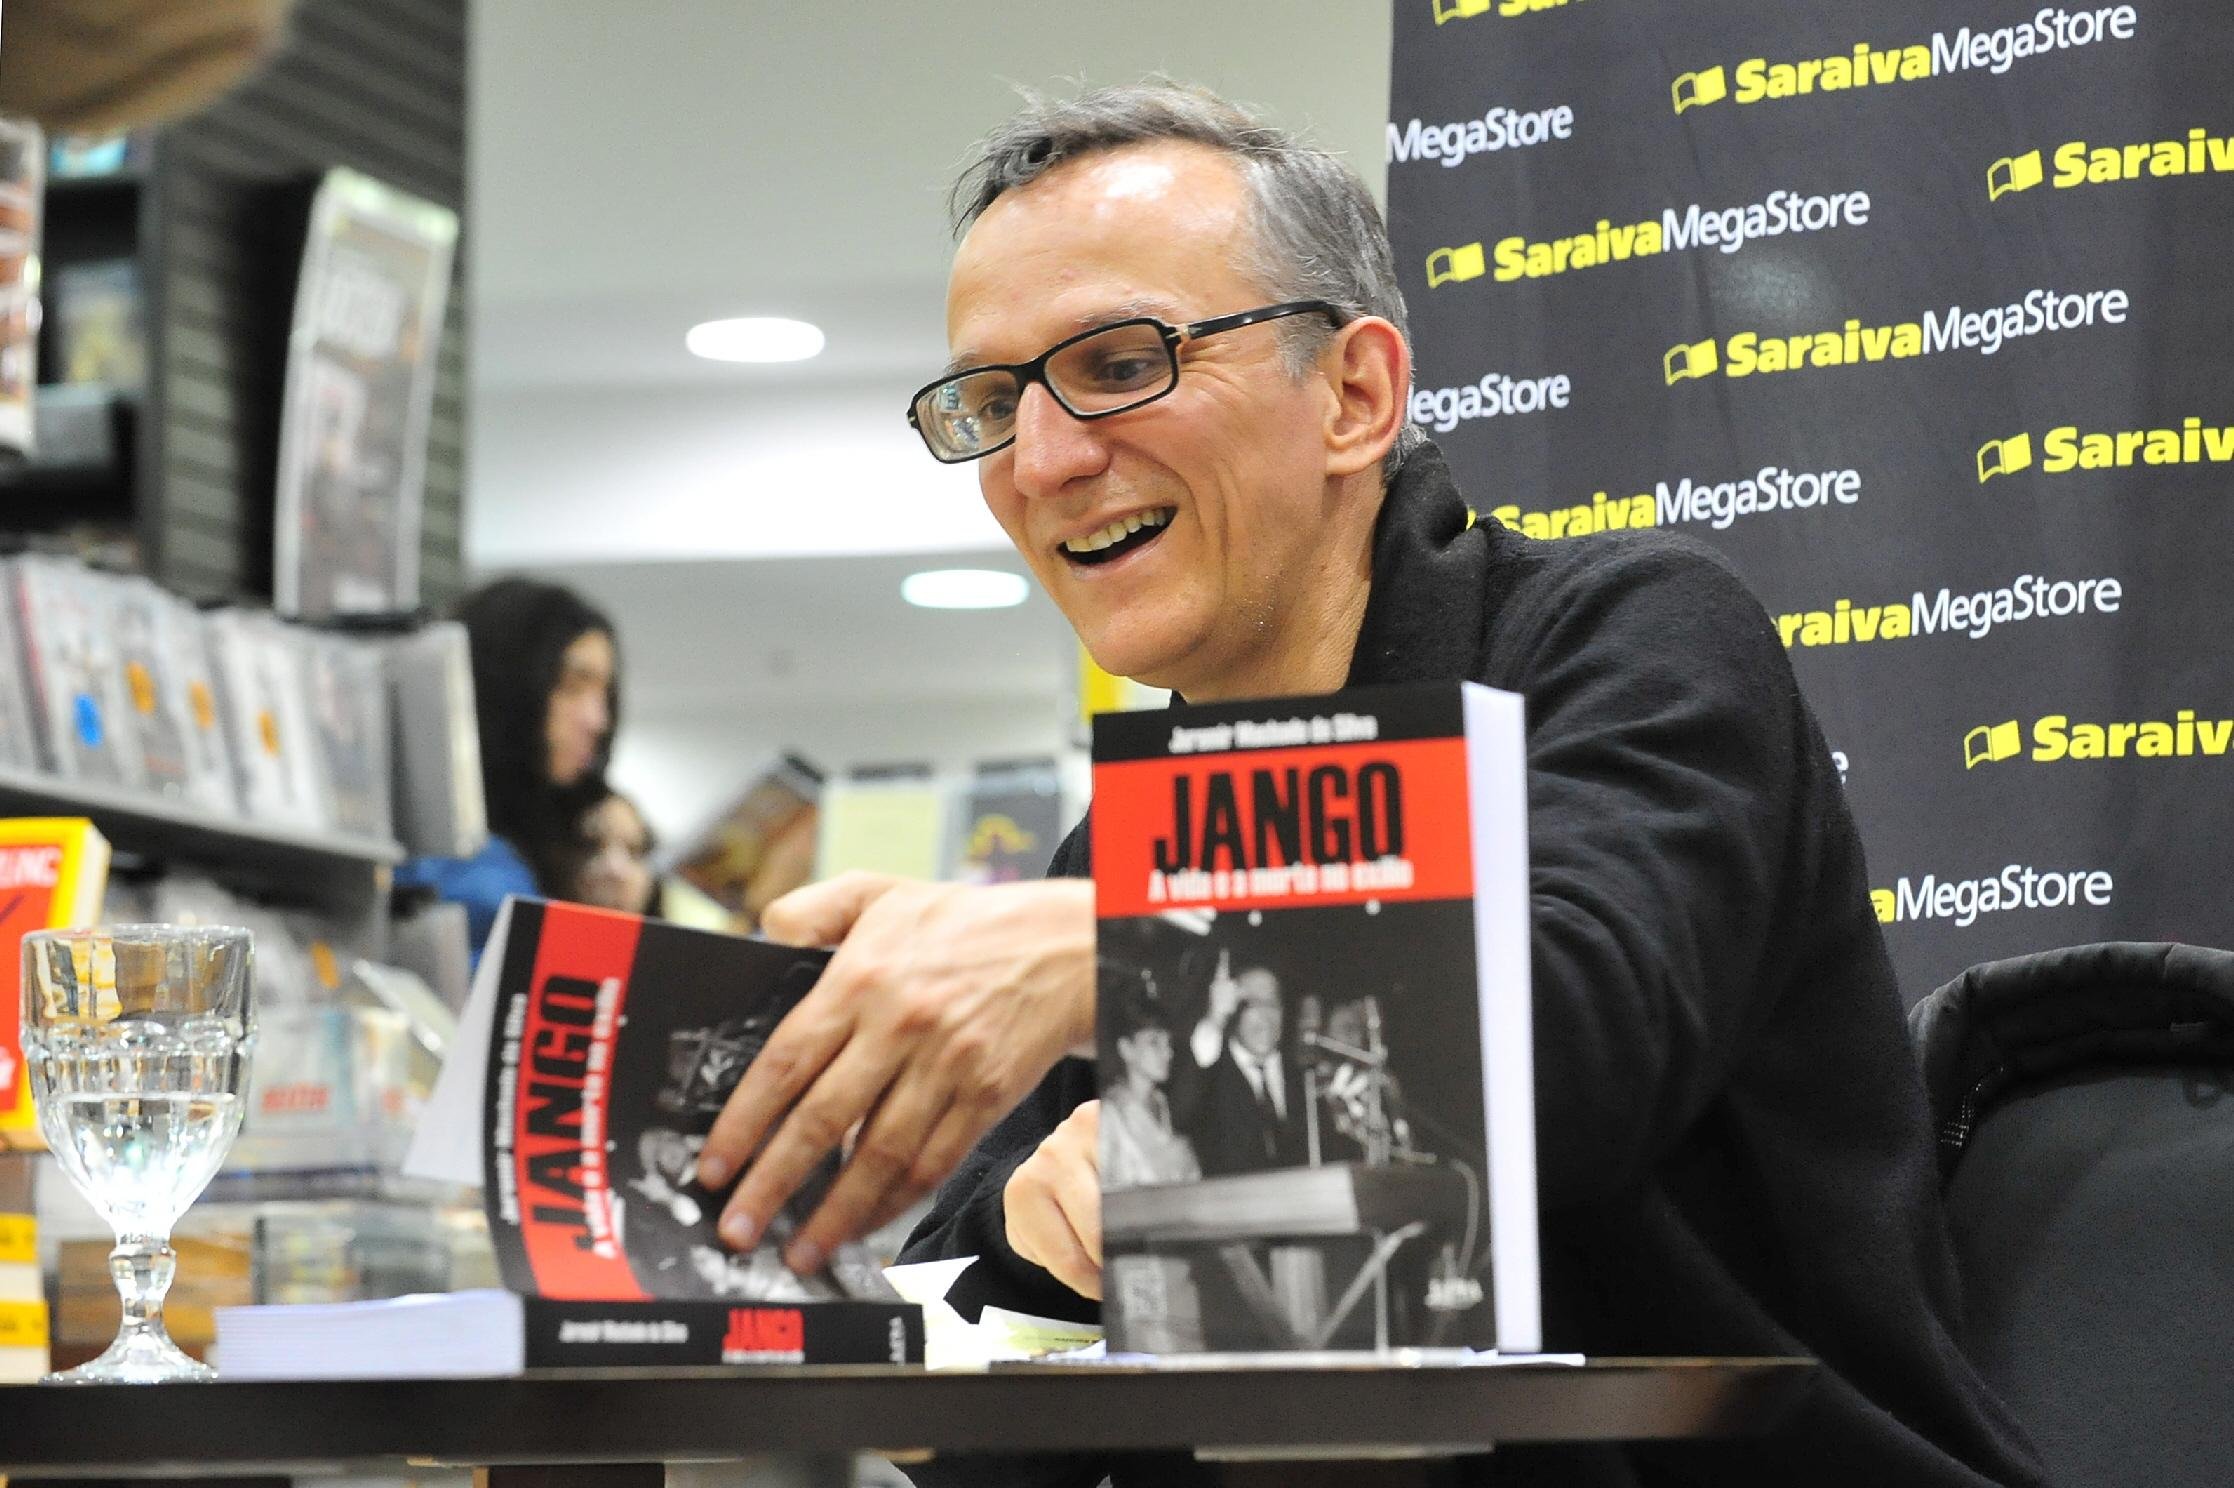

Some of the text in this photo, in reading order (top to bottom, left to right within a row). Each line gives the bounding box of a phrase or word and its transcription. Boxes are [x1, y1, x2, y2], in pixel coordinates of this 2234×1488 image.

[1735, 4, 2137, 104] SaraivaMegaStore
[1387, 105, 1574, 168] MegaStore
[1493, 190, 1871, 282] SaraivaMegaStore
[1725, 289, 2129, 378] SaraivaMegaStore
[1407, 372, 1571, 433] egaStore
[1770, 574, 2123, 649] raivaMegaStore
[2031, 710, 2234, 762] Saraiv
[1154, 761, 1404, 876] JANGO
[526, 974, 601, 1252] JANGO
